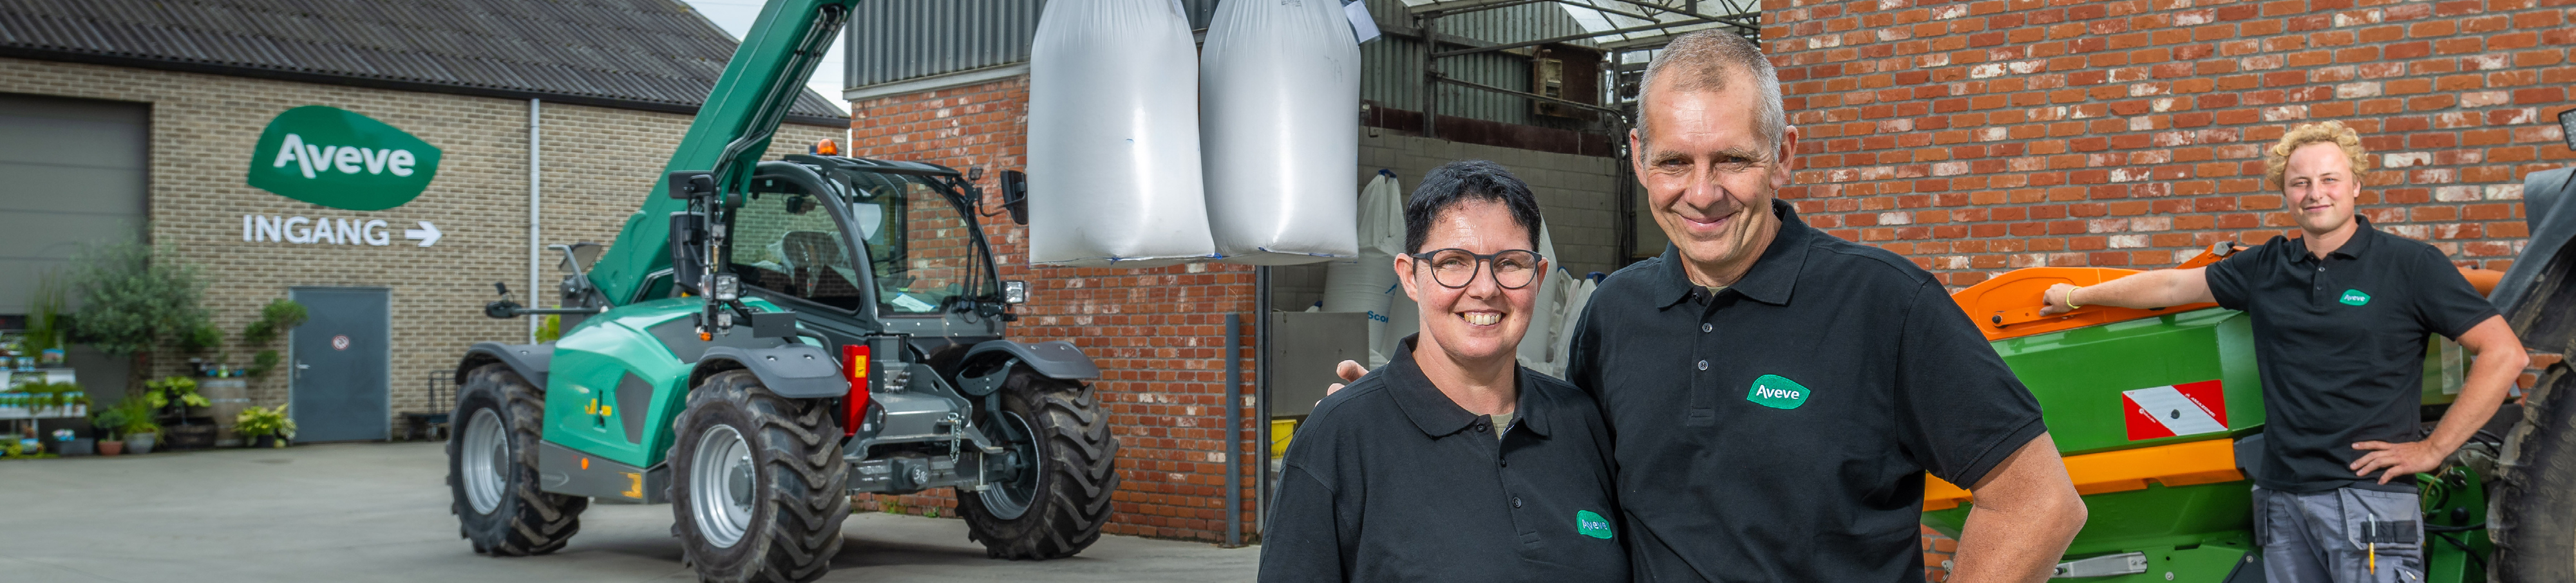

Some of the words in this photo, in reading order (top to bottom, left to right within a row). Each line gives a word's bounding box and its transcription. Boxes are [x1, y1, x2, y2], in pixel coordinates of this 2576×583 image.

[273, 133, 415, 180] Aveve
[243, 214, 390, 246] INGANG
[1756, 384, 1800, 400] Aveve
[1582, 519, 1608, 532] Aveve
